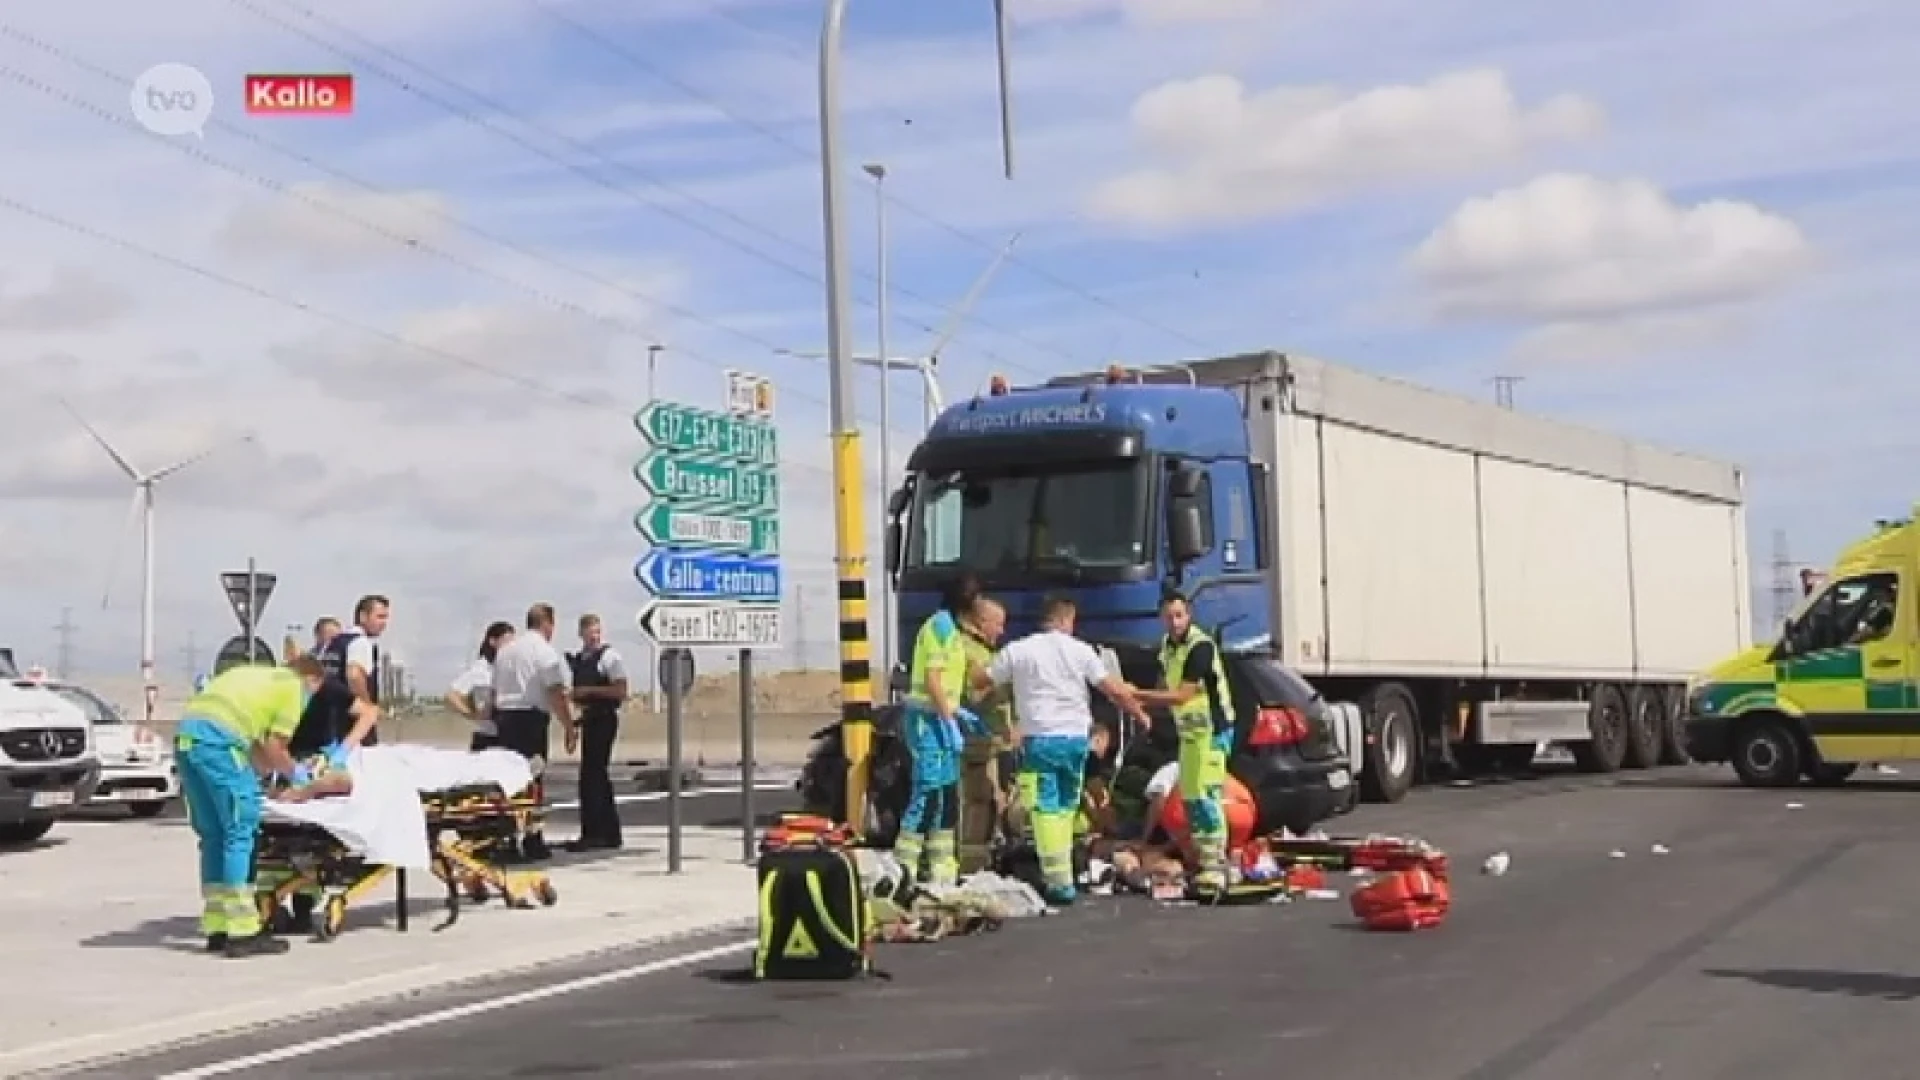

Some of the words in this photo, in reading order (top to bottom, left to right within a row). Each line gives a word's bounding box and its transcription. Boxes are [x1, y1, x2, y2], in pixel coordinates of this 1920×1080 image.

[665, 459, 734, 500] Brussel
[662, 559, 777, 595] Kallo-centrum
[660, 609, 703, 638] Haven
